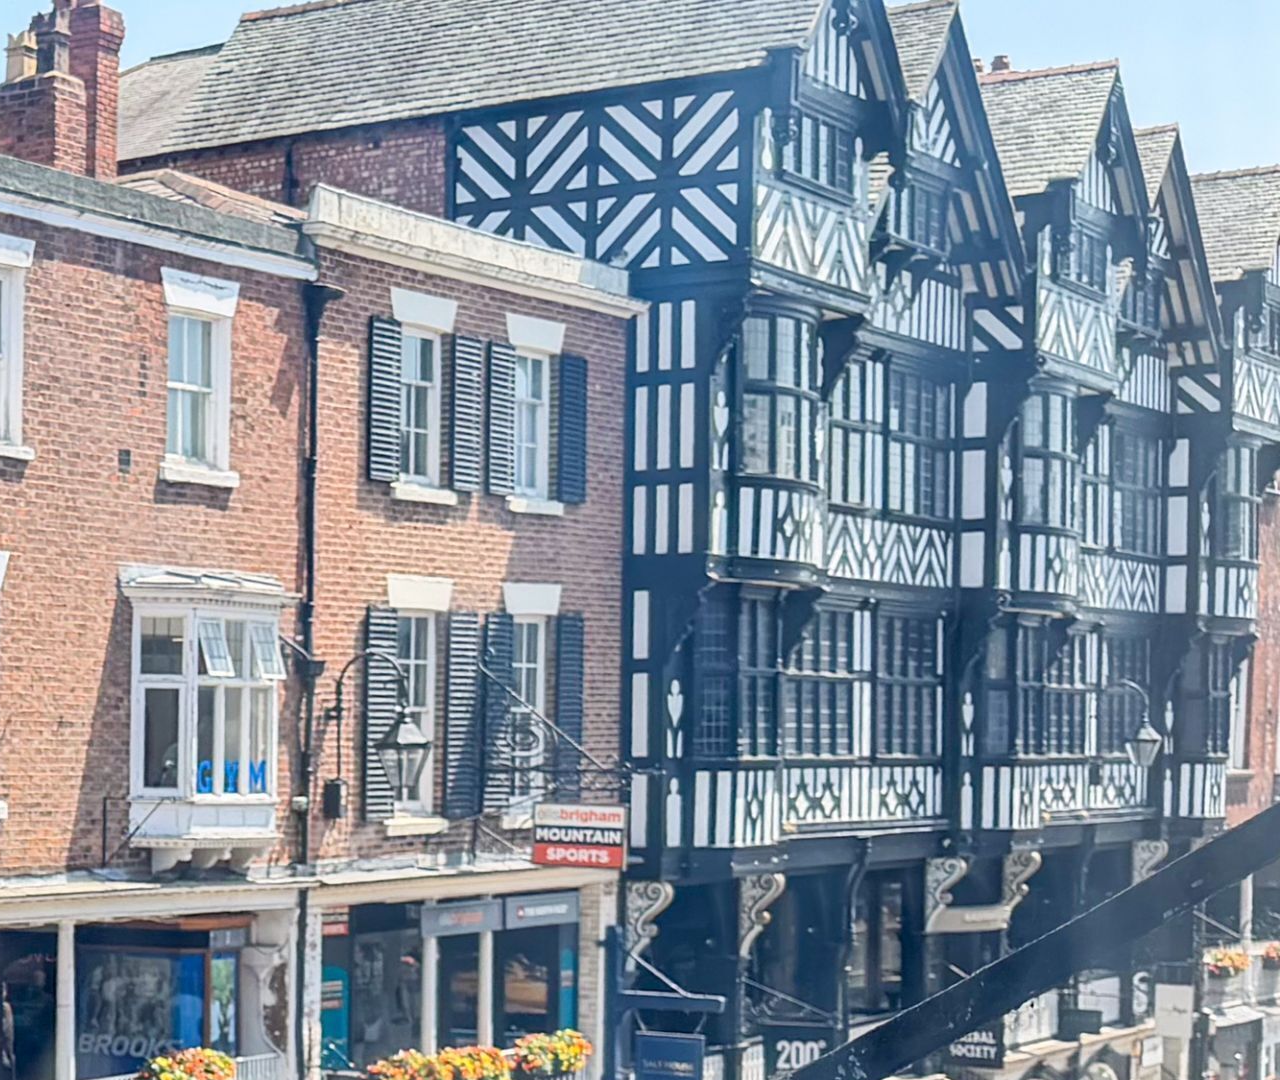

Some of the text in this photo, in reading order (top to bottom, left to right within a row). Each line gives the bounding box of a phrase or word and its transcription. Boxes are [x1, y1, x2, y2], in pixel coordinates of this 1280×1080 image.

[536, 827, 621, 844] MOUNTAIN
[546, 847, 610, 864] SPORTS
[80, 1033, 180, 1059] BROOKS
